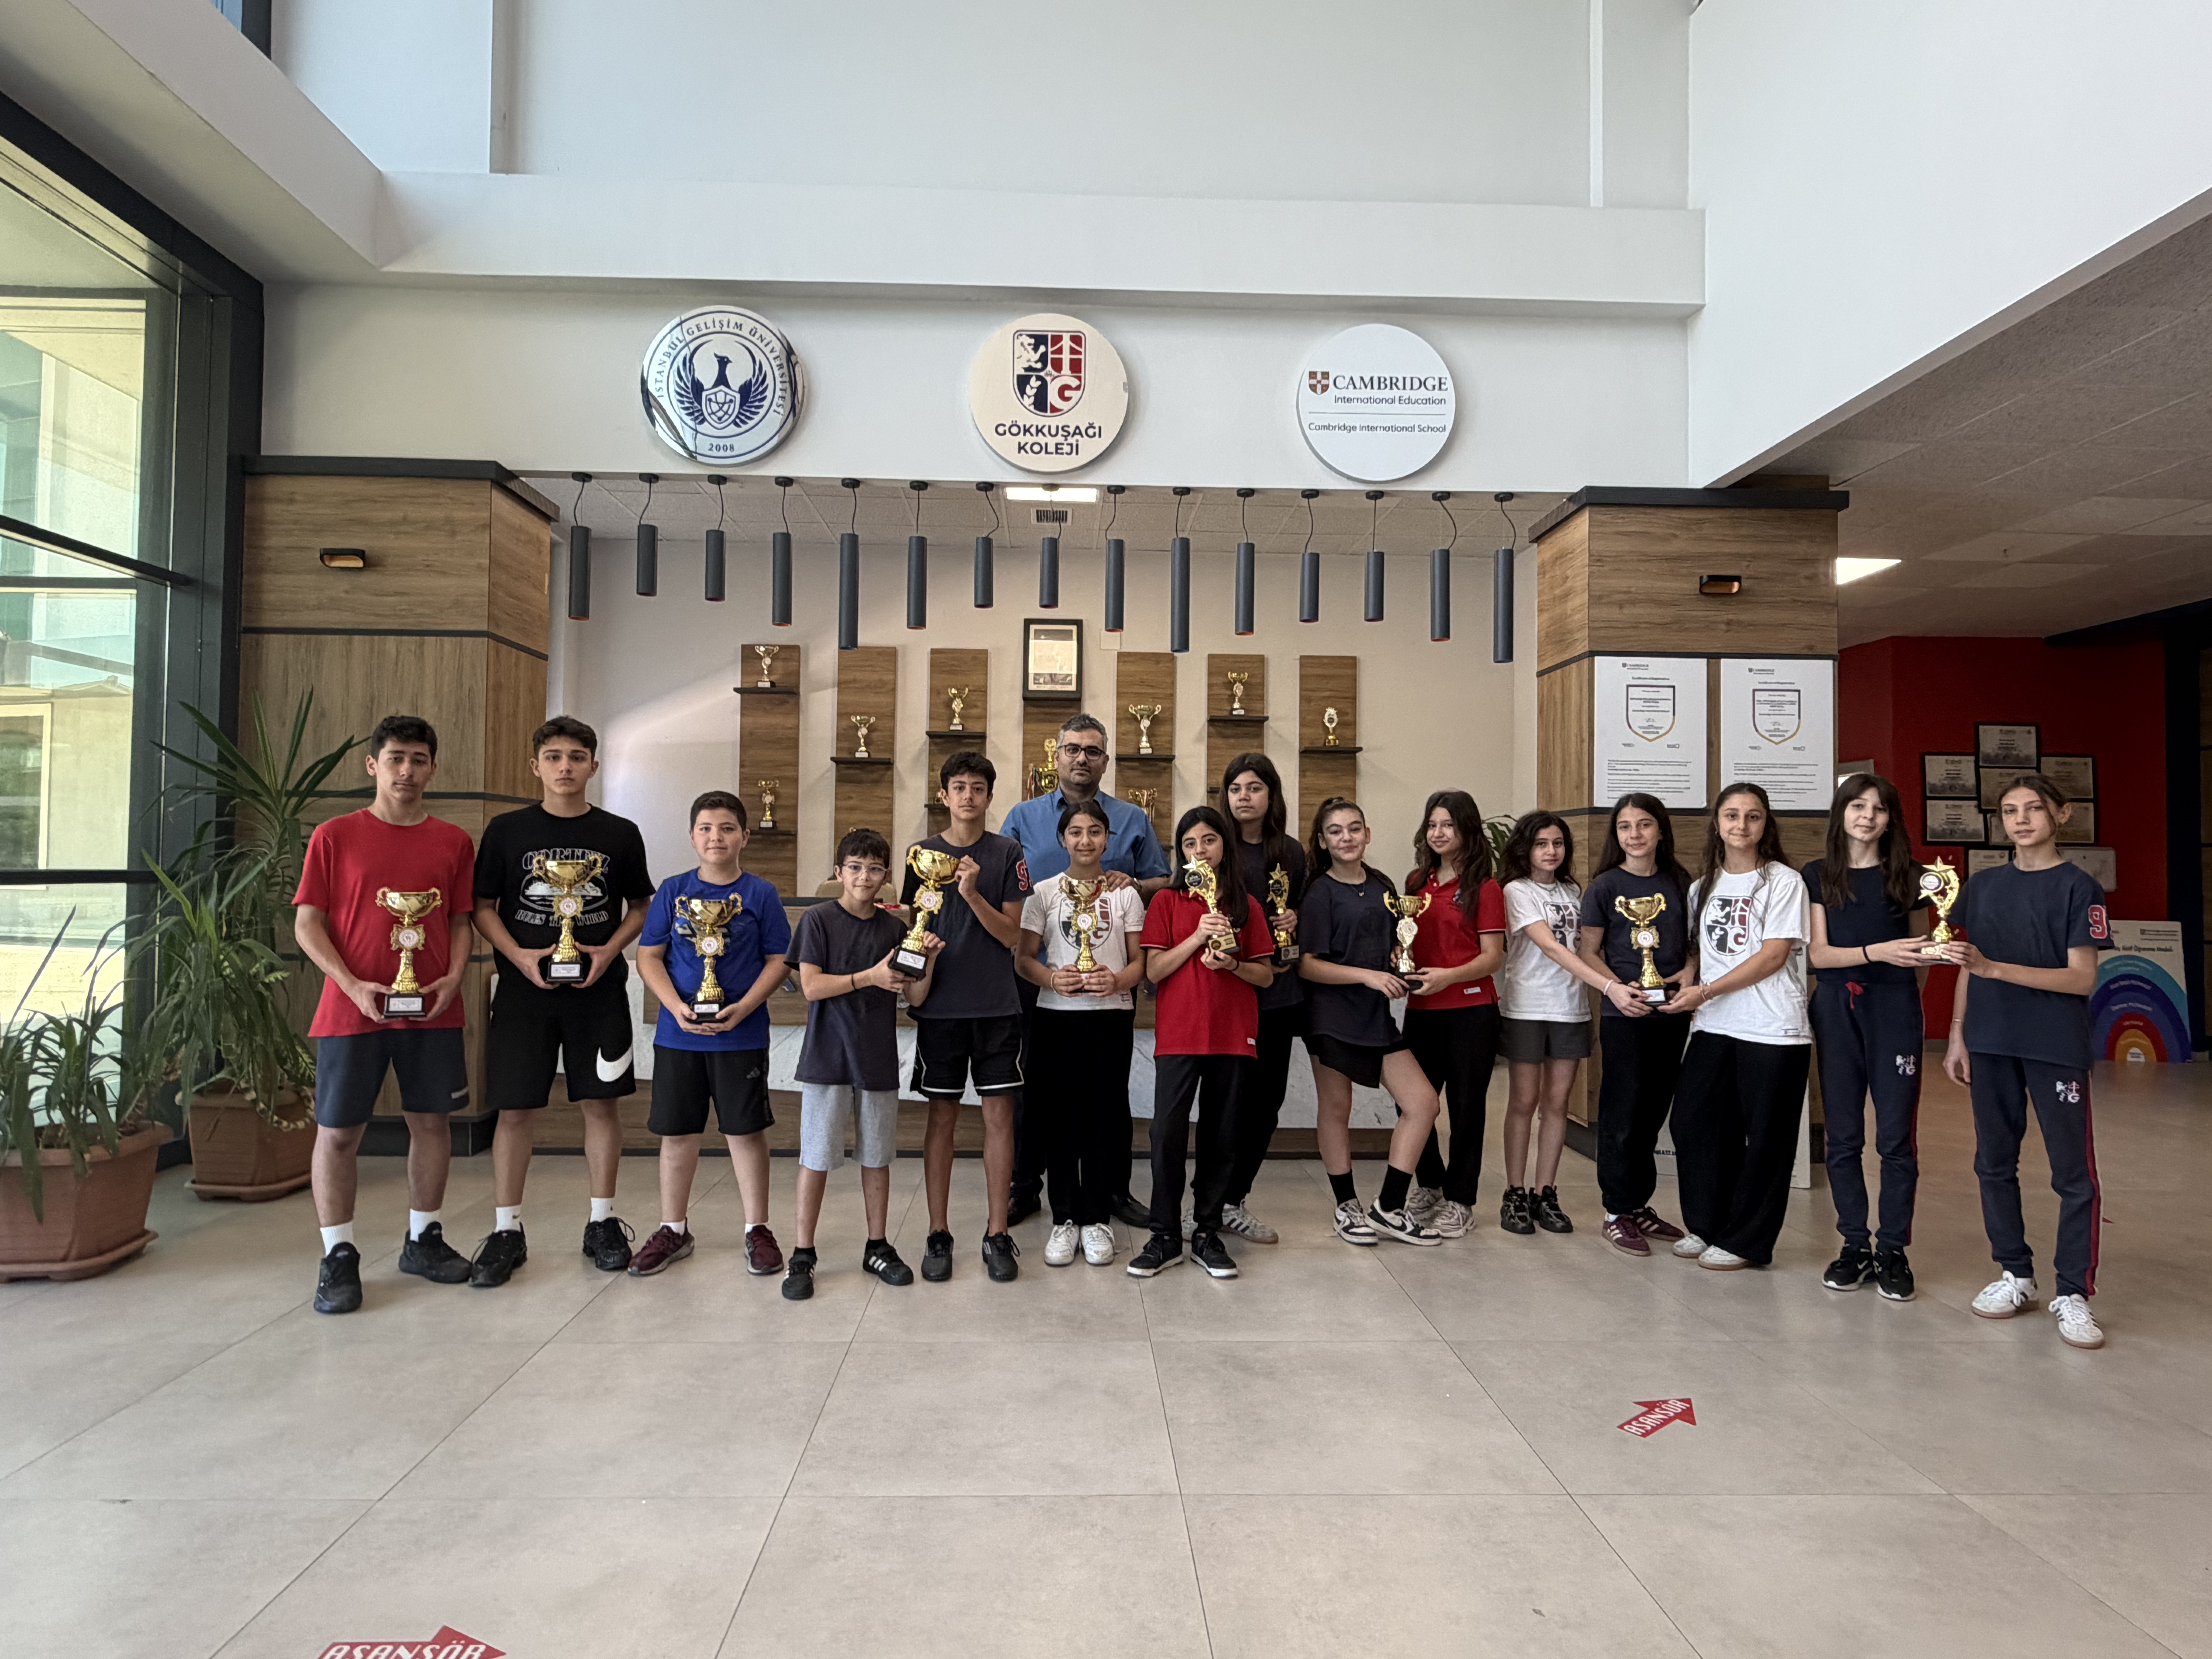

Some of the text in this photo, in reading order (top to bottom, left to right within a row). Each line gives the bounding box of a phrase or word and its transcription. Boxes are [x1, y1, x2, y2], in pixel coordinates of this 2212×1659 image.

[687, 317, 743, 335] GELİŞİM
[749, 326, 789, 416] ÜNİVERSİTESİ
[1333, 375, 1448, 391] CAMBRIDGE
[1334, 395, 1446, 405] International Education
[994, 420, 1102, 441] GÖKKUŞAĞI
[1309, 422, 1446, 433] Cambridge International School
[708, 443, 734, 452] 2008
[1018, 439, 1079, 455] KOLEJİ
[1623, 1400, 1690, 1435] ASANSÖR
